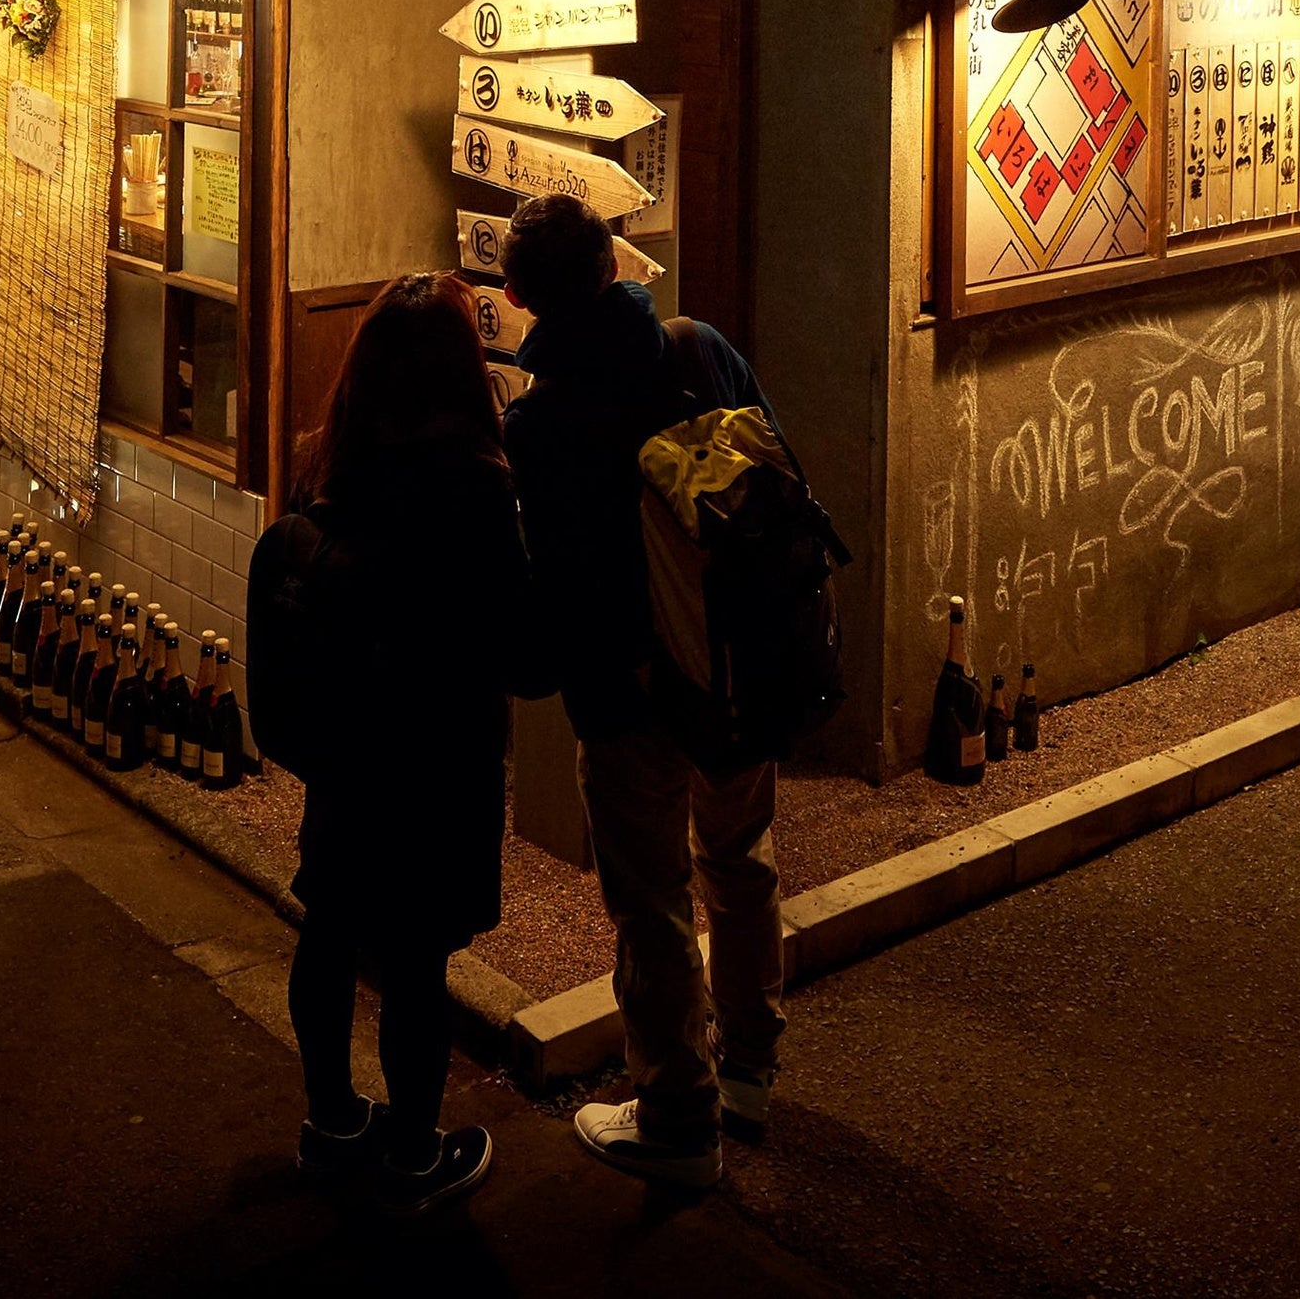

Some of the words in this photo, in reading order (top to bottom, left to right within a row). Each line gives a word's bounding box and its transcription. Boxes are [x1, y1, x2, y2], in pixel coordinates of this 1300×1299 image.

[475, 73, 496, 107] ろ
[996, 115, 1012, 137] い
[468, 134, 488, 172] は
[646, 126, 656, 192] 外ではお静か
[1012, 145, 1027, 168] ろ
[1069, 153, 1086, 179] に
[520, 166, 587, 199] Azzurro520
[1033, 171, 1052, 198] は
[474, 227, 494, 258] に
[990, 360, 1268, 519] WELCOME
